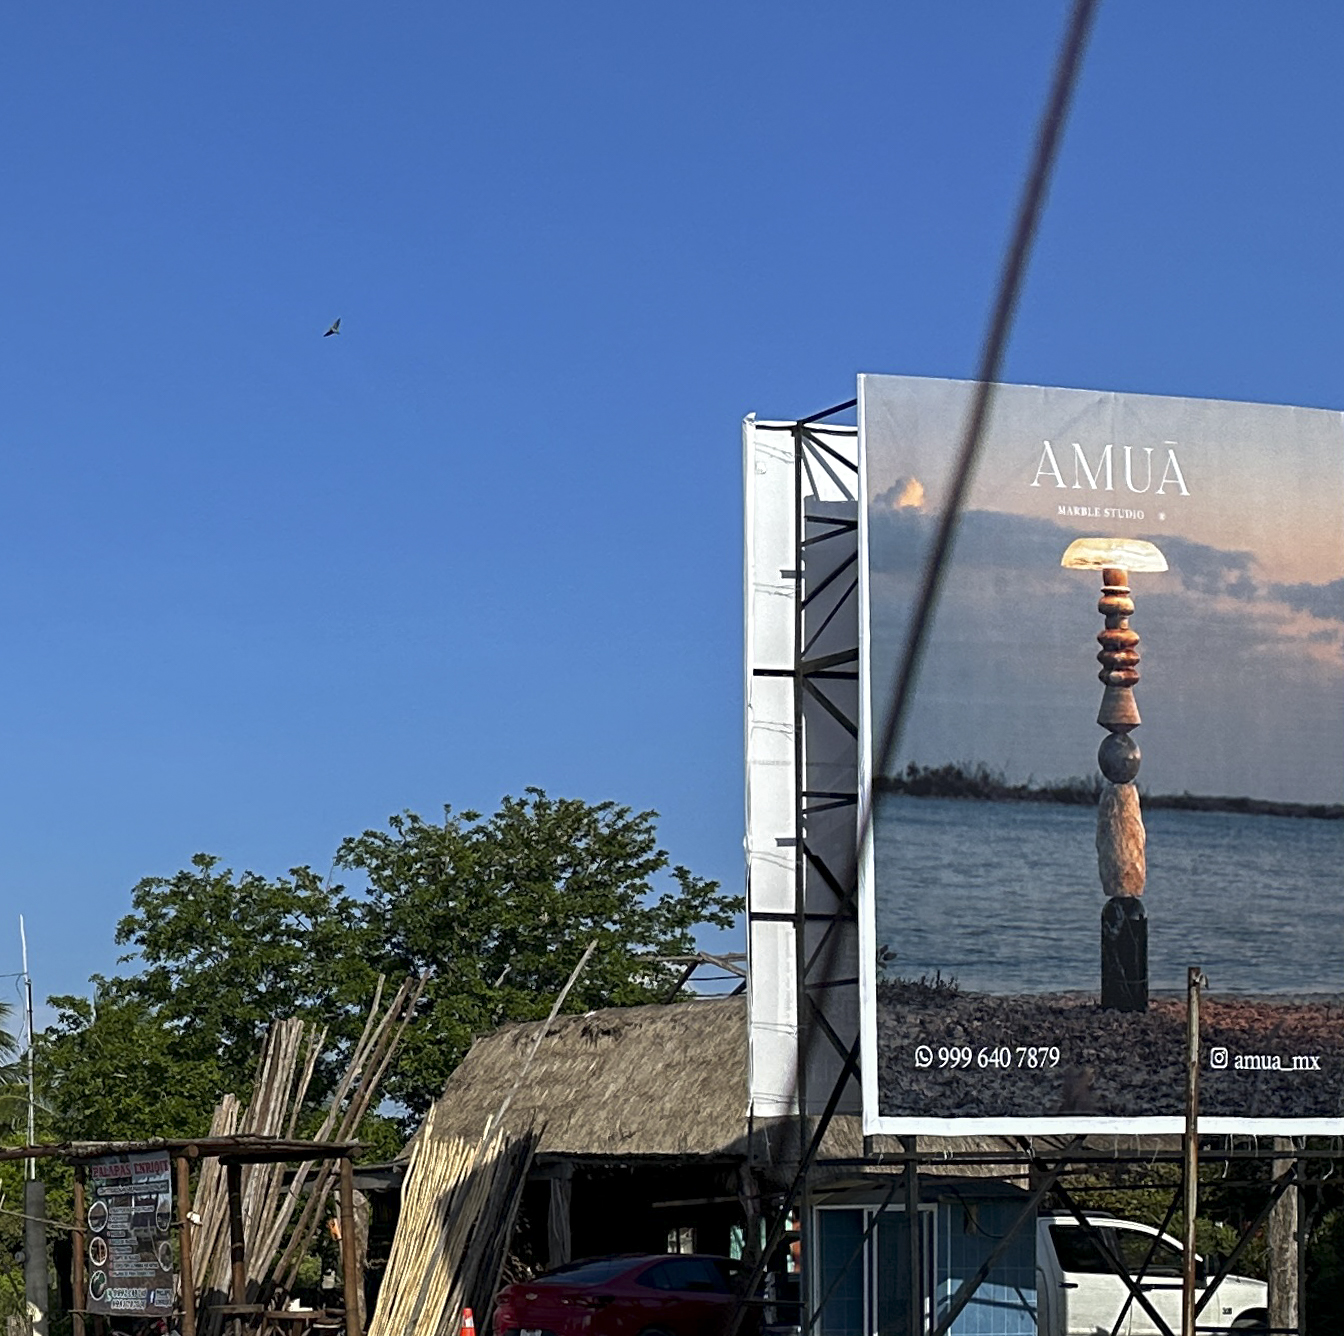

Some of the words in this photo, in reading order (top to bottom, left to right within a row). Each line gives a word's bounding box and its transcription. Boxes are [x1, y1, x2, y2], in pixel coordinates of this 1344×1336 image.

[1058, 505, 1101, 517] MARBLE
[1103, 508, 1145, 520] STUDIO
[938, 1047, 972, 1068] 999
[977, 1047, 1011, 1069] 640
[1015, 1047, 1060, 1069] 7879
[1234, 1053, 1321, 1071] amua_mx
